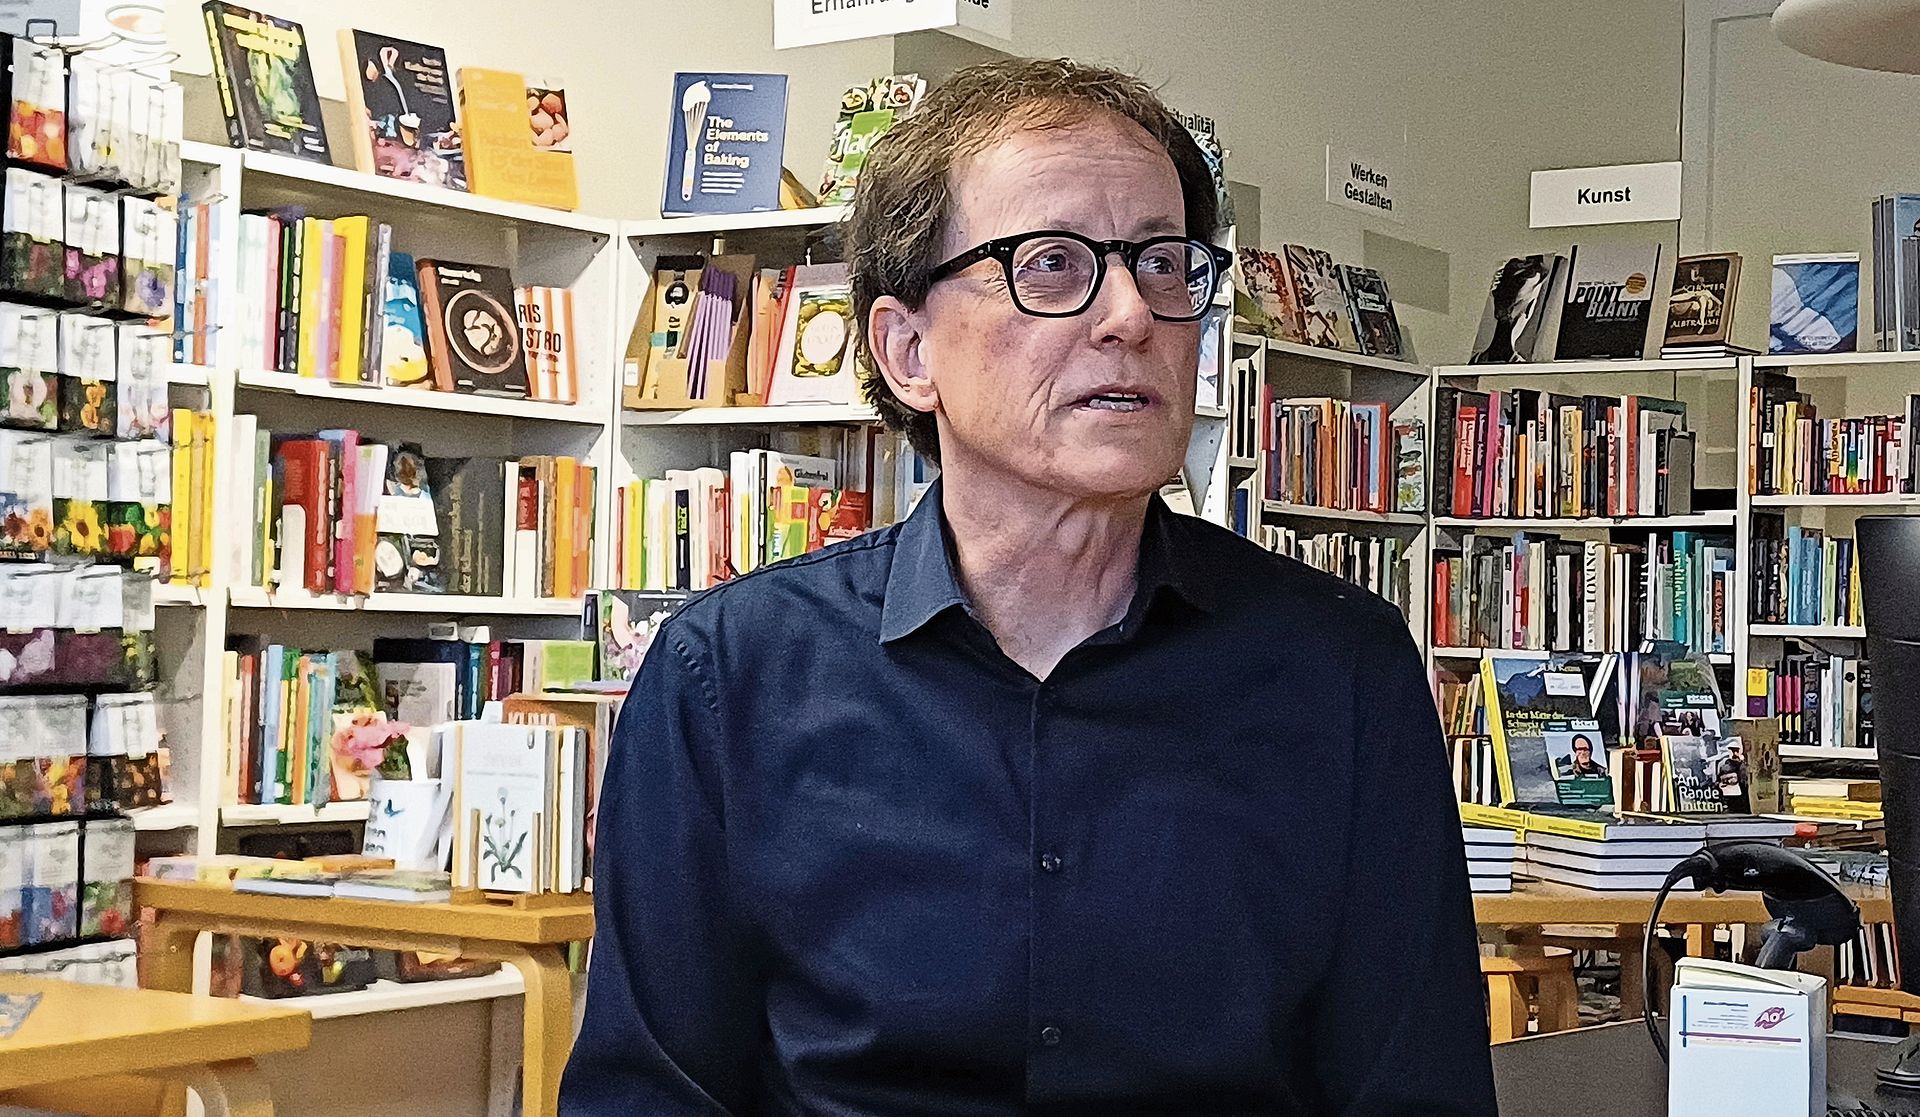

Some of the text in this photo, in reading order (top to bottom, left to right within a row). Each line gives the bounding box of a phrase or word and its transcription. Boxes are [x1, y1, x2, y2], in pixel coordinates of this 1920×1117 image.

[706, 115, 733, 129] The
[706, 129, 769, 143] Elements
[704, 141, 720, 153] of
[703, 154, 750, 169] Baking
[1350, 162, 1388, 189] Werken
[1344, 182, 1393, 211] Gestalten
[1577, 186, 1631, 205] Kunst
[1574, 285, 1627, 303] POINT
[518, 303, 541, 323] RIS
[1585, 301, 1642, 318] BLANK
[525, 328, 562, 354] STRO
[1585, 544, 1597, 604] LOVING
[1677, 774, 1699, 787] Am
[1678, 786, 1720, 801] Rande
